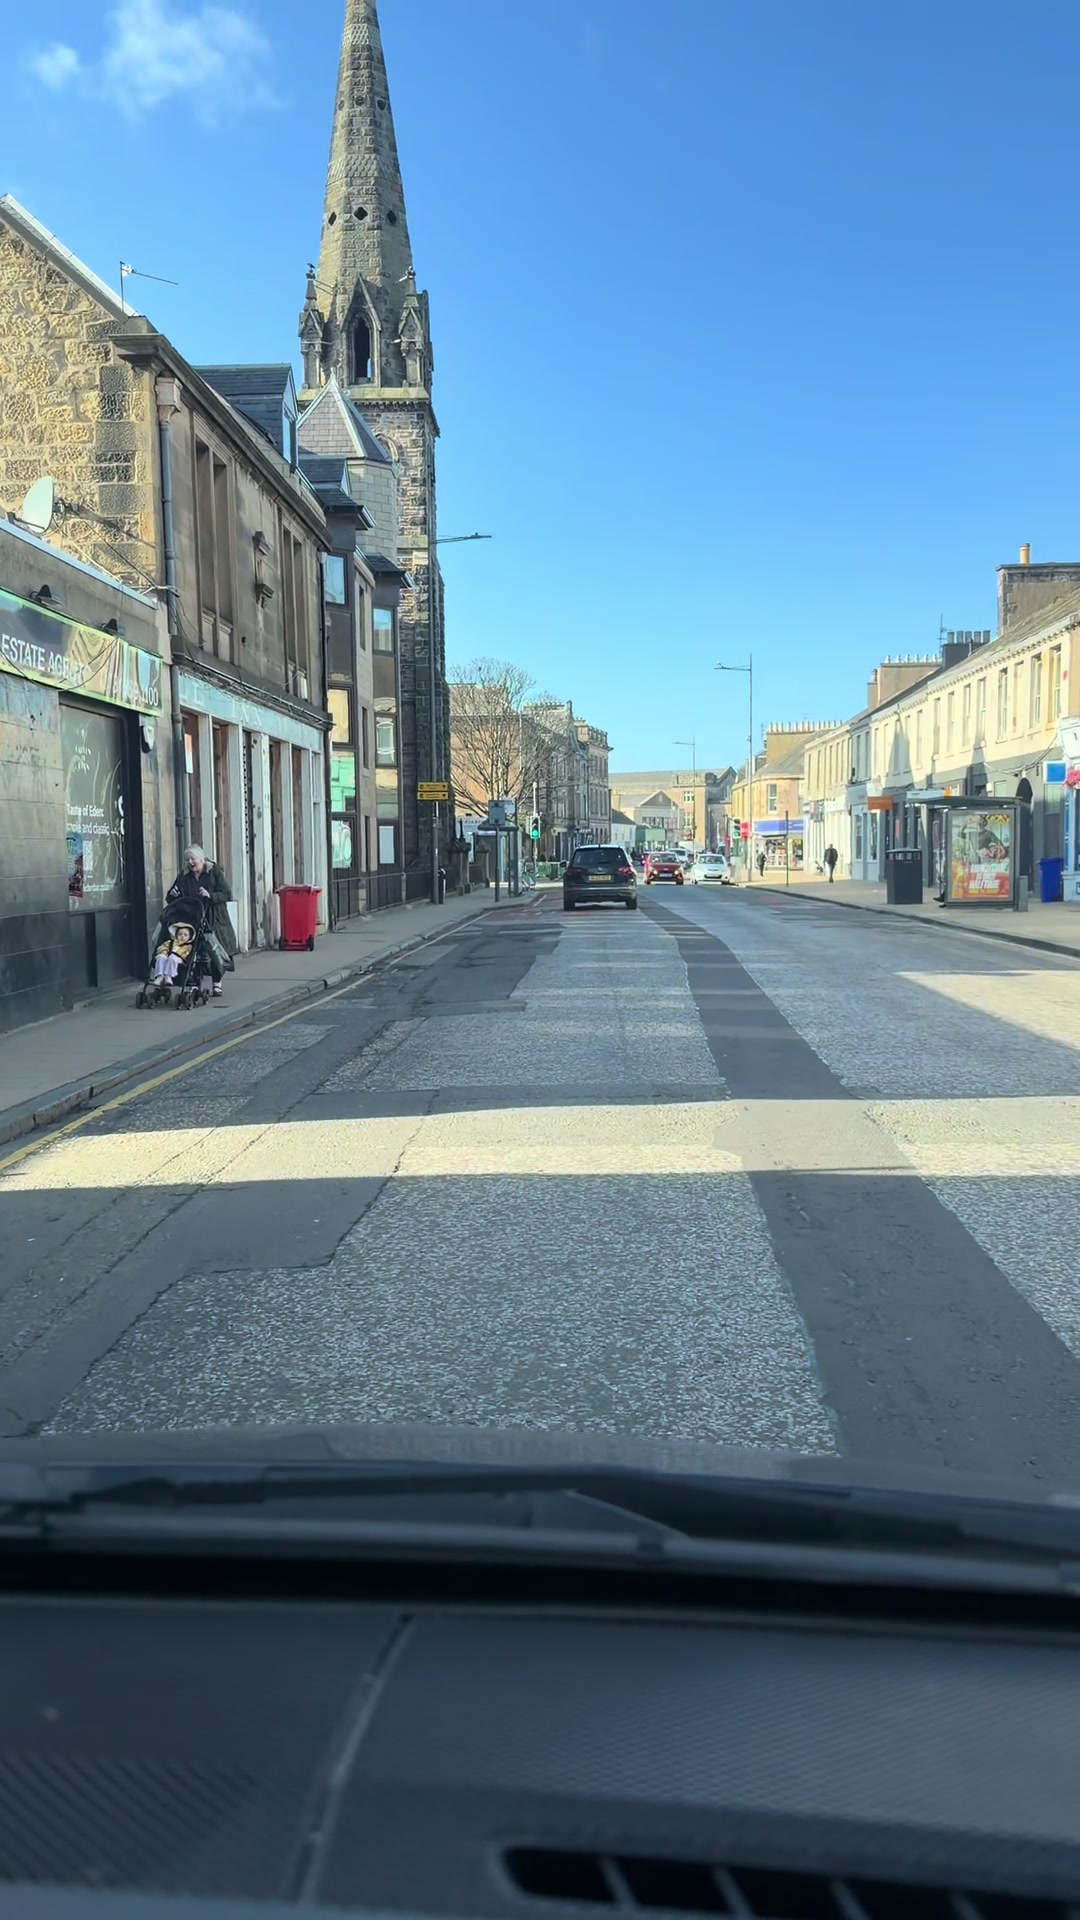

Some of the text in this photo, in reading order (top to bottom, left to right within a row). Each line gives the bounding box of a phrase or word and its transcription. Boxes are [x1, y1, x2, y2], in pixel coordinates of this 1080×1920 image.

[2, 633, 46, 671] ESTATE
[83, 804, 88, 816] of
[82, 821, 92, 834] and
